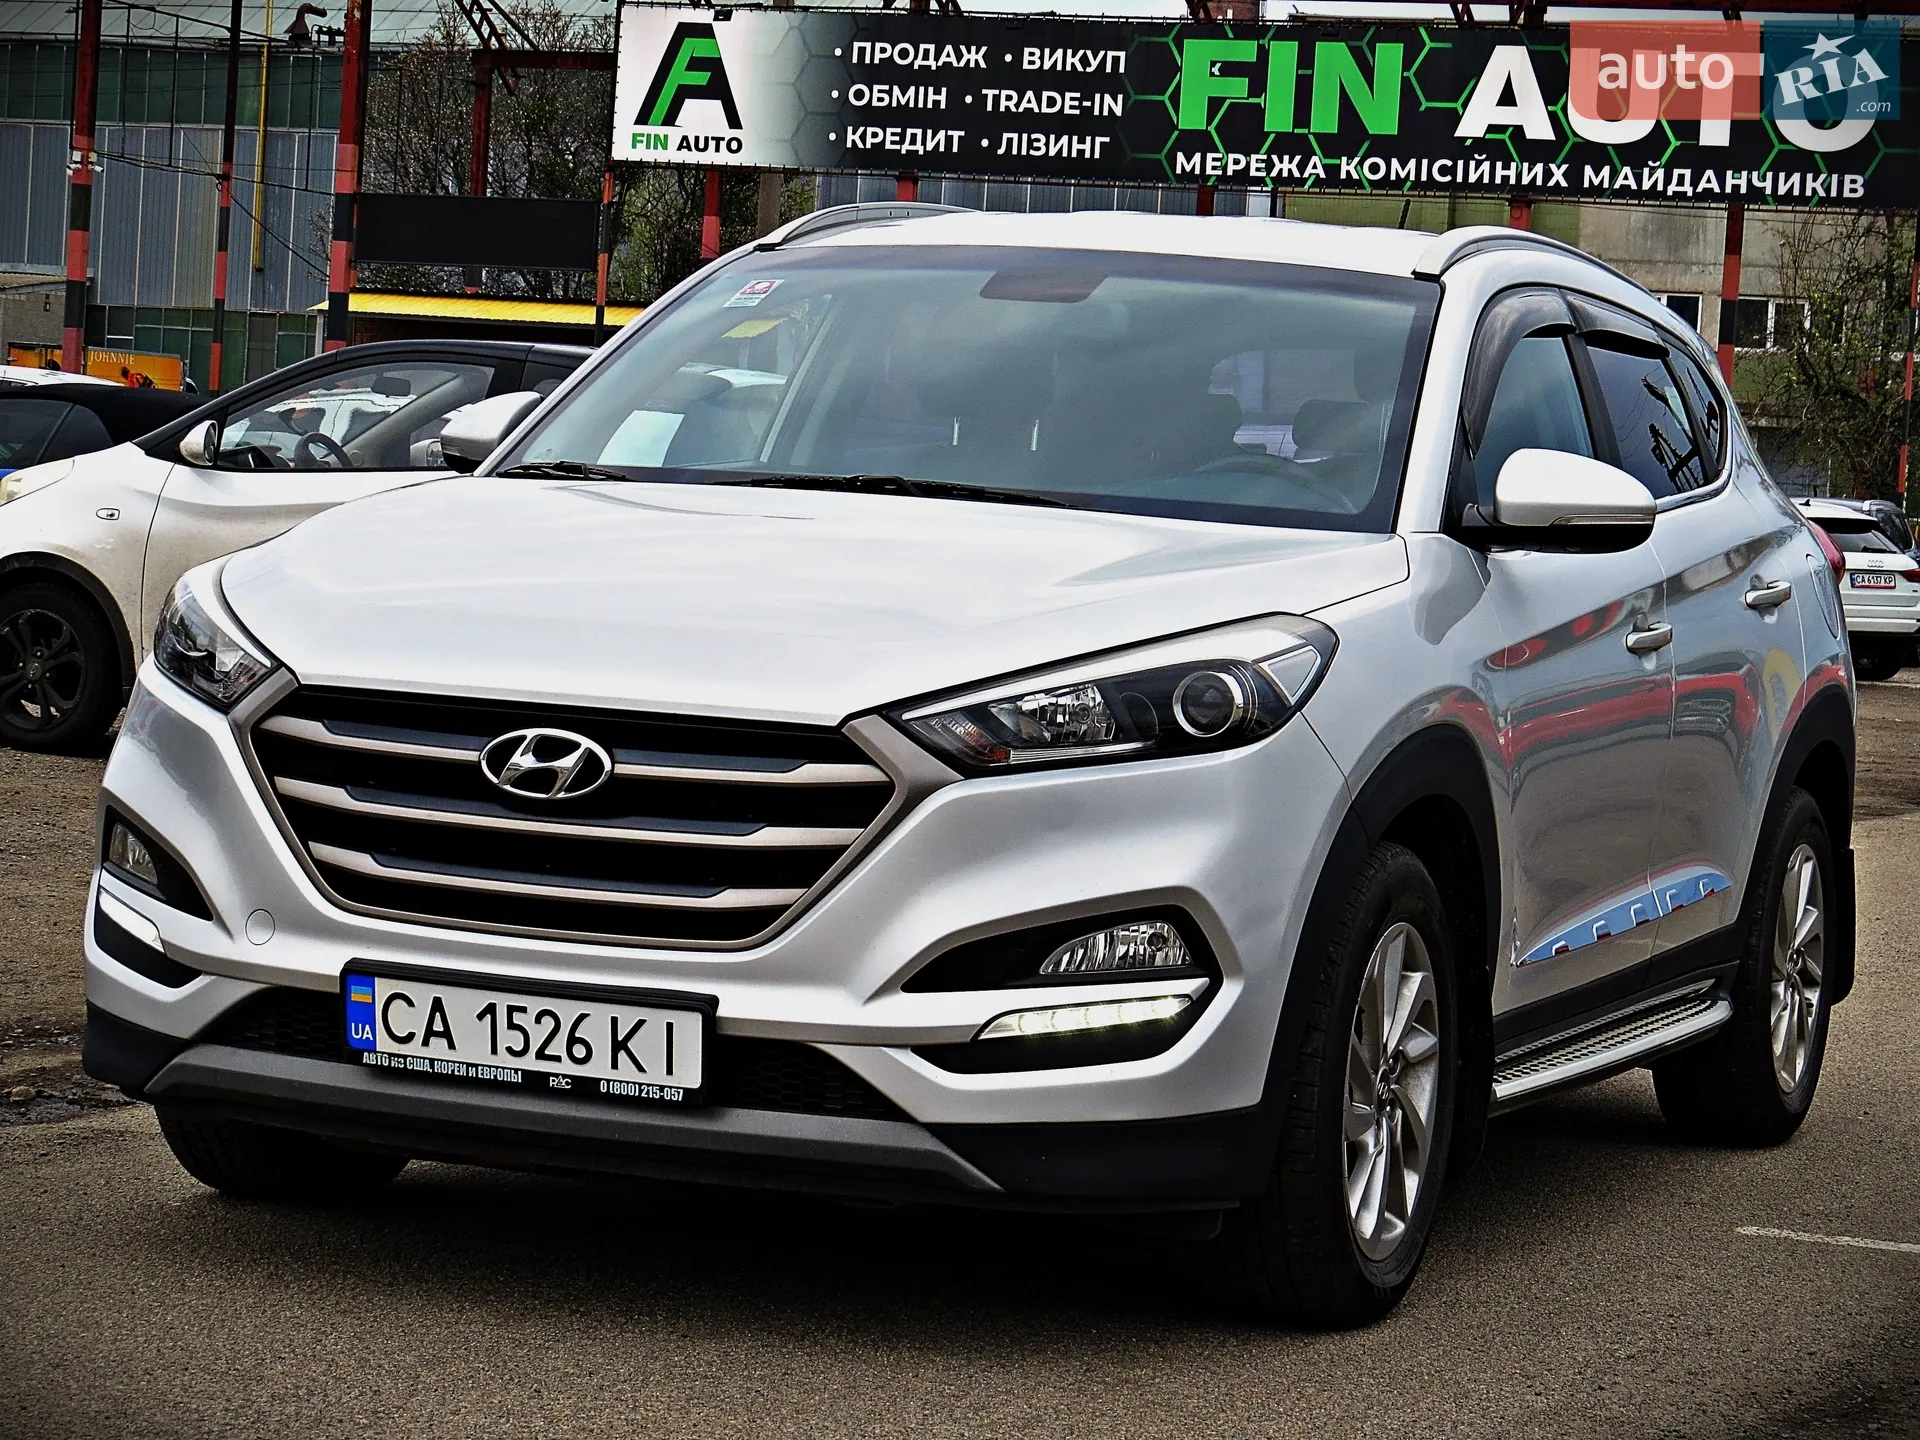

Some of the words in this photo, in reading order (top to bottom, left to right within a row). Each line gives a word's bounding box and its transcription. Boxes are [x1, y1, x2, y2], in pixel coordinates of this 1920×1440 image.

[851, 41, 988, 71] ПРОДАЖ
[1021, 48, 1127, 74] ВИКУП
[847, 83, 948, 110] ОБМІН
[1177, 38, 1405, 136] FIN
[981, 88, 1125, 117] TRADE-IN
[630, 132, 670, 151] FIN
[675, 135, 744, 155] AUTO
[845, 125, 966, 156] КРЕДИТ
[996, 132, 1111, 159] ЛІЗИНГ
[1174, 151, 1327, 180] МЕРЕЖА
[1340, 152, 1571, 189] КОМІСІЙНИХ
[1582, 159, 1867, 199] МАЙДАНЧИКІВ
[88, 350, 136, 365] JOHNNIE
[1855, 575, 1866, 585] CA
[350, 1021, 374, 1042] UA
[380, 991, 458, 1052] CA
[475, 1001, 594, 1066] 1526
[609, 1014, 675, 1077] KI
[362, 1052, 389, 1067] АВТО
[406, 1057, 433, 1074] США,
[478, 1066, 523, 1083] ЕВРОПЫ
[600, 1080, 608, 1093] 0
[609, 1081, 640, 1097] (800)
[640, 1084, 684, 1101] 215-057
